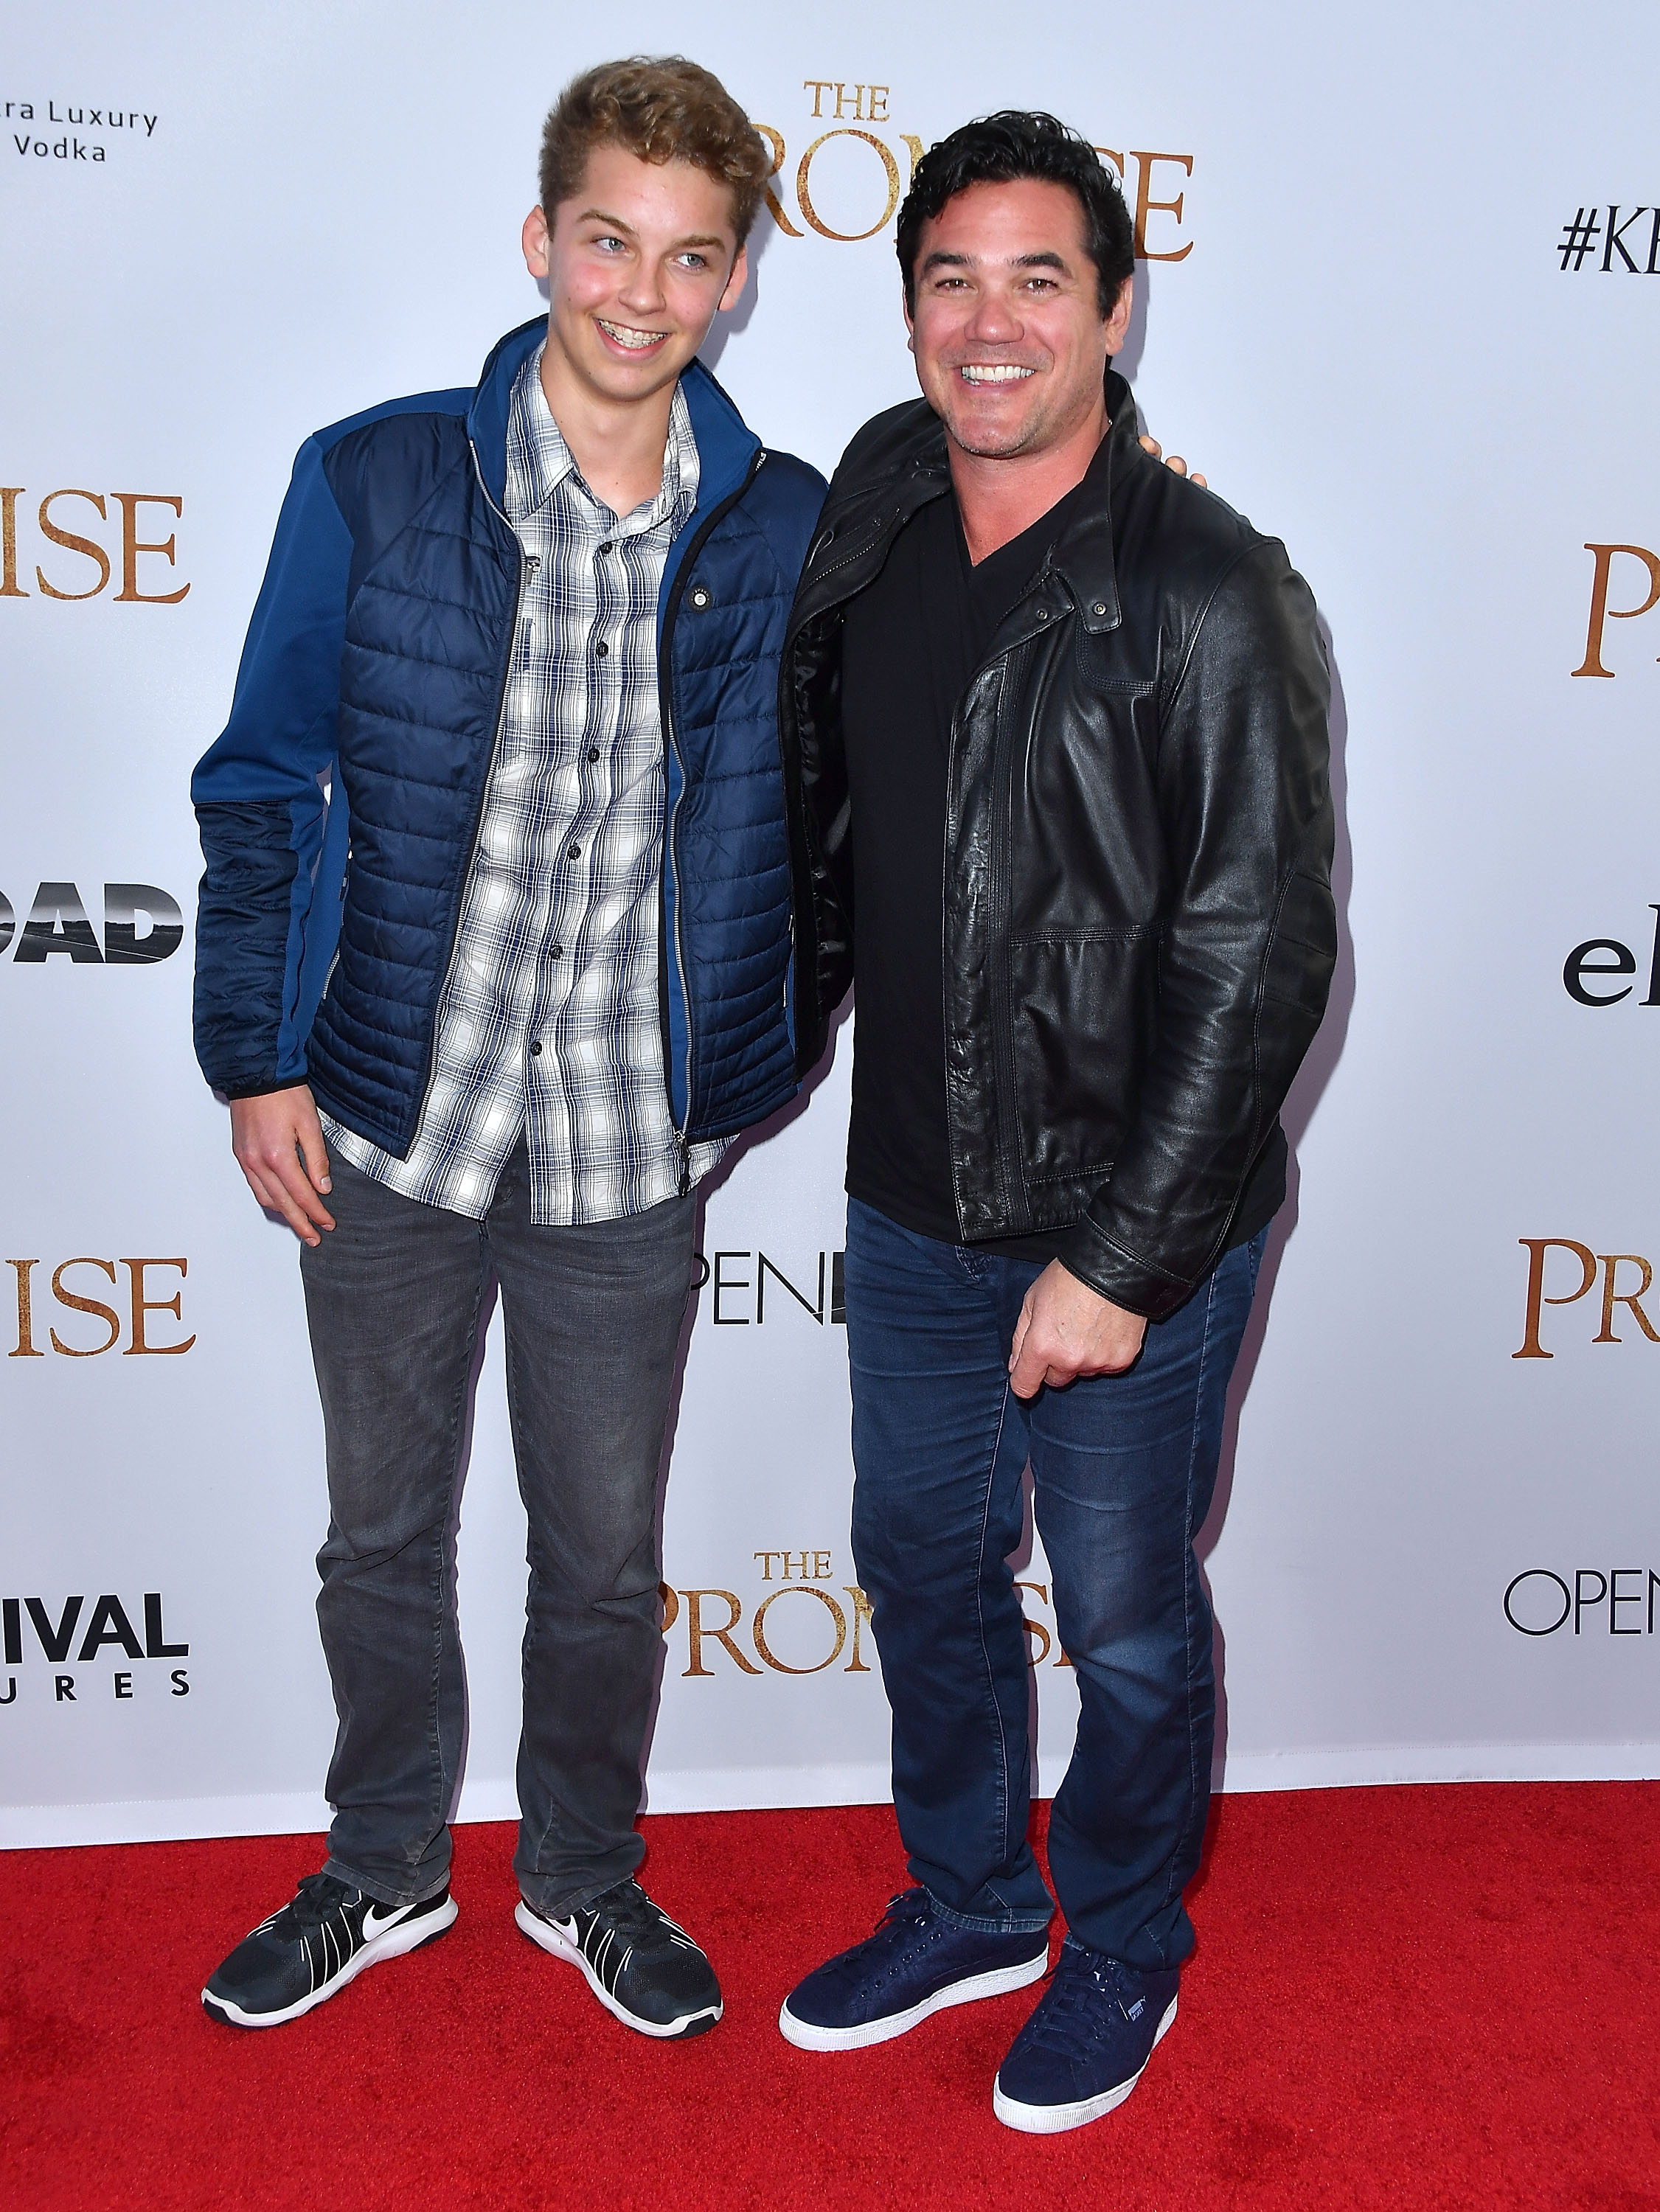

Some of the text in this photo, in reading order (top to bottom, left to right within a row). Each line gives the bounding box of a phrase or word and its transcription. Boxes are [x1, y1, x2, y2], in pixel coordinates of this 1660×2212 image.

[0, 101, 158, 137] ra Luxury
[803, 80, 890, 122] THE
[13, 134, 106, 162] Vodka
[0, 487, 190, 604] ISE
[1570, 543, 1660, 678] P
[0, 881, 184, 964] AD
[4, 1256, 196, 1357] ISE
[754, 1550, 833, 1581] THE
[1, 1593, 190, 1664] IVAL
